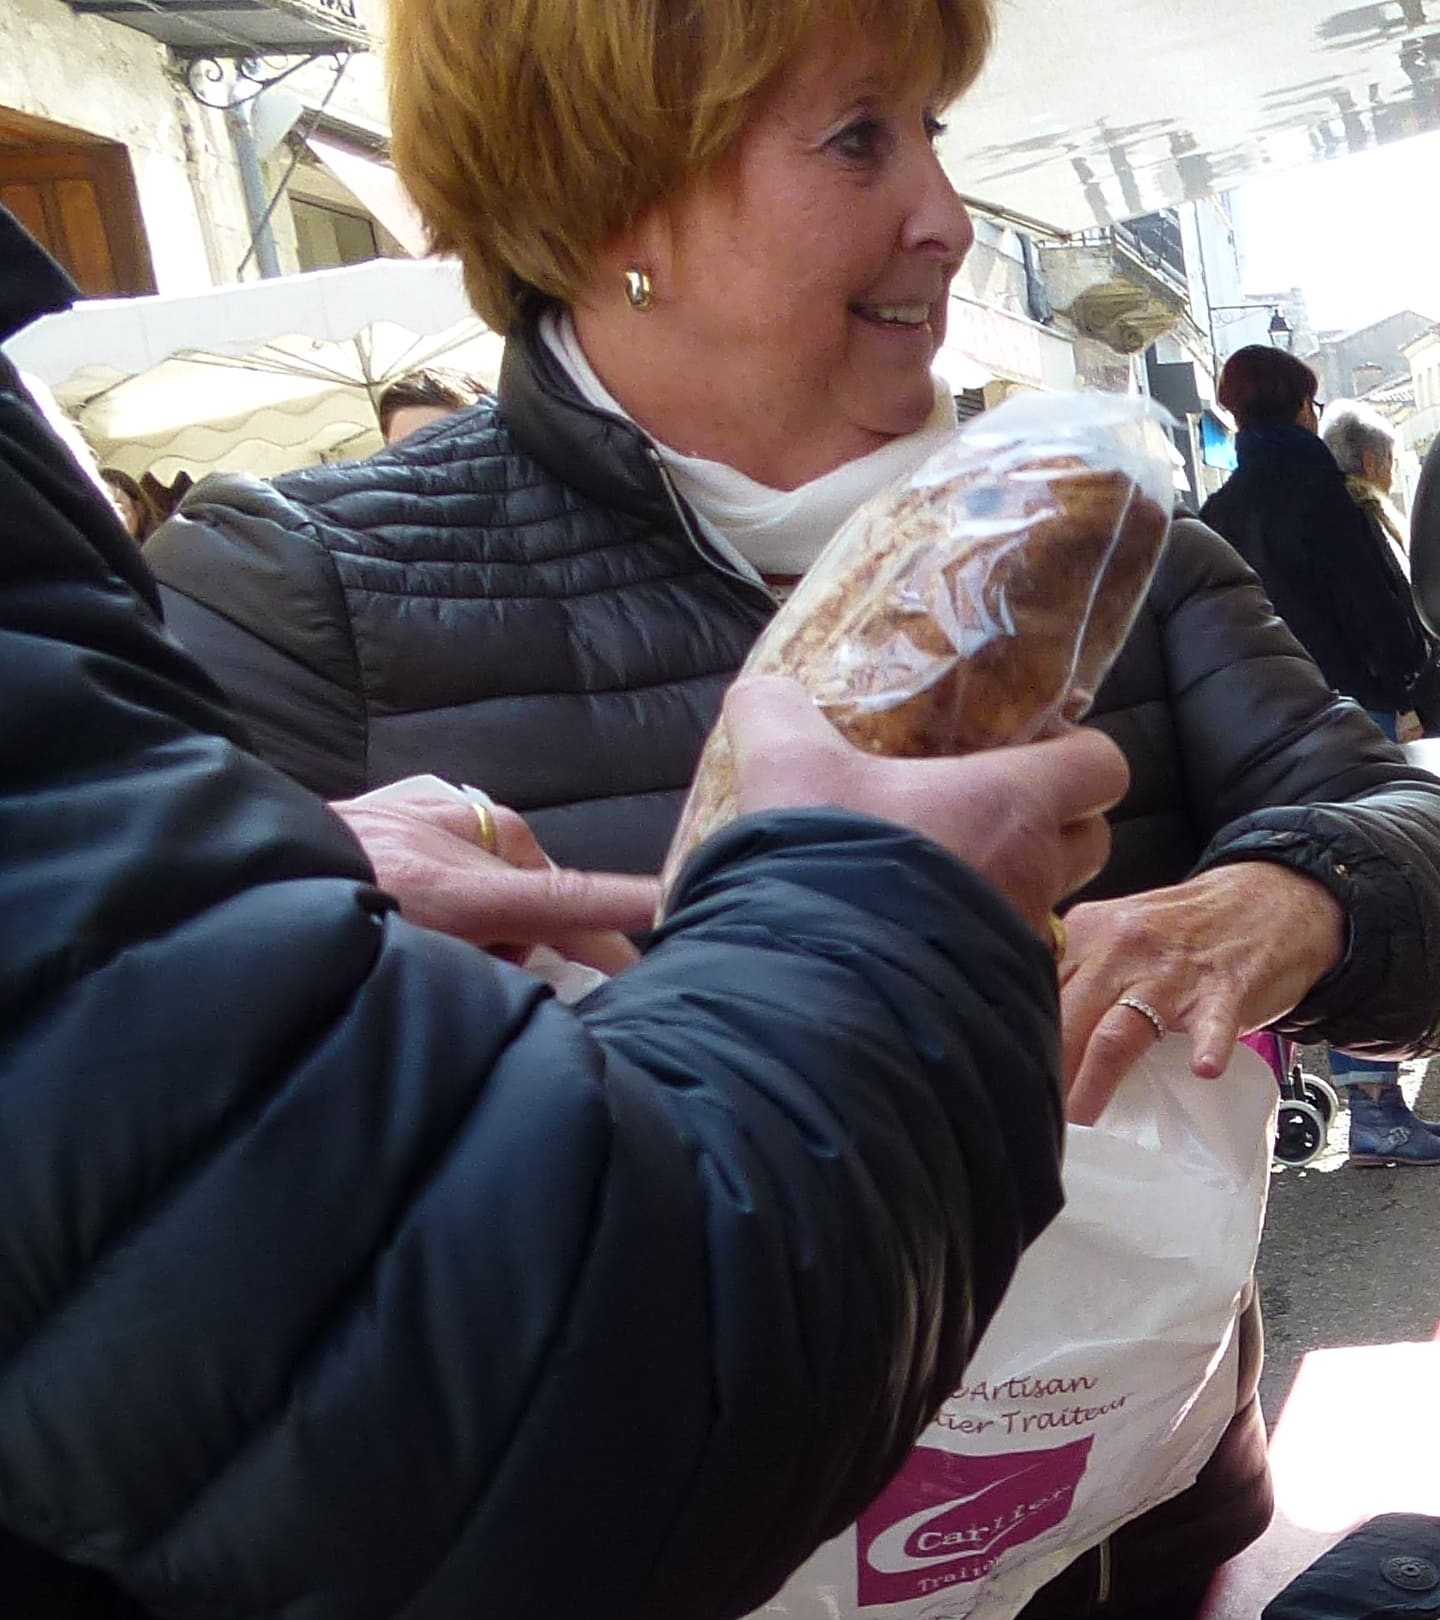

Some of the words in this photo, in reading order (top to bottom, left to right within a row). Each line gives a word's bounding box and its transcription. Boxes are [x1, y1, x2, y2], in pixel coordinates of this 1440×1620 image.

[970, 1374, 1099, 1402] Artisan
[935, 1412, 995, 1434] tier
[1001, 1393, 1136, 1434] Traiteur
